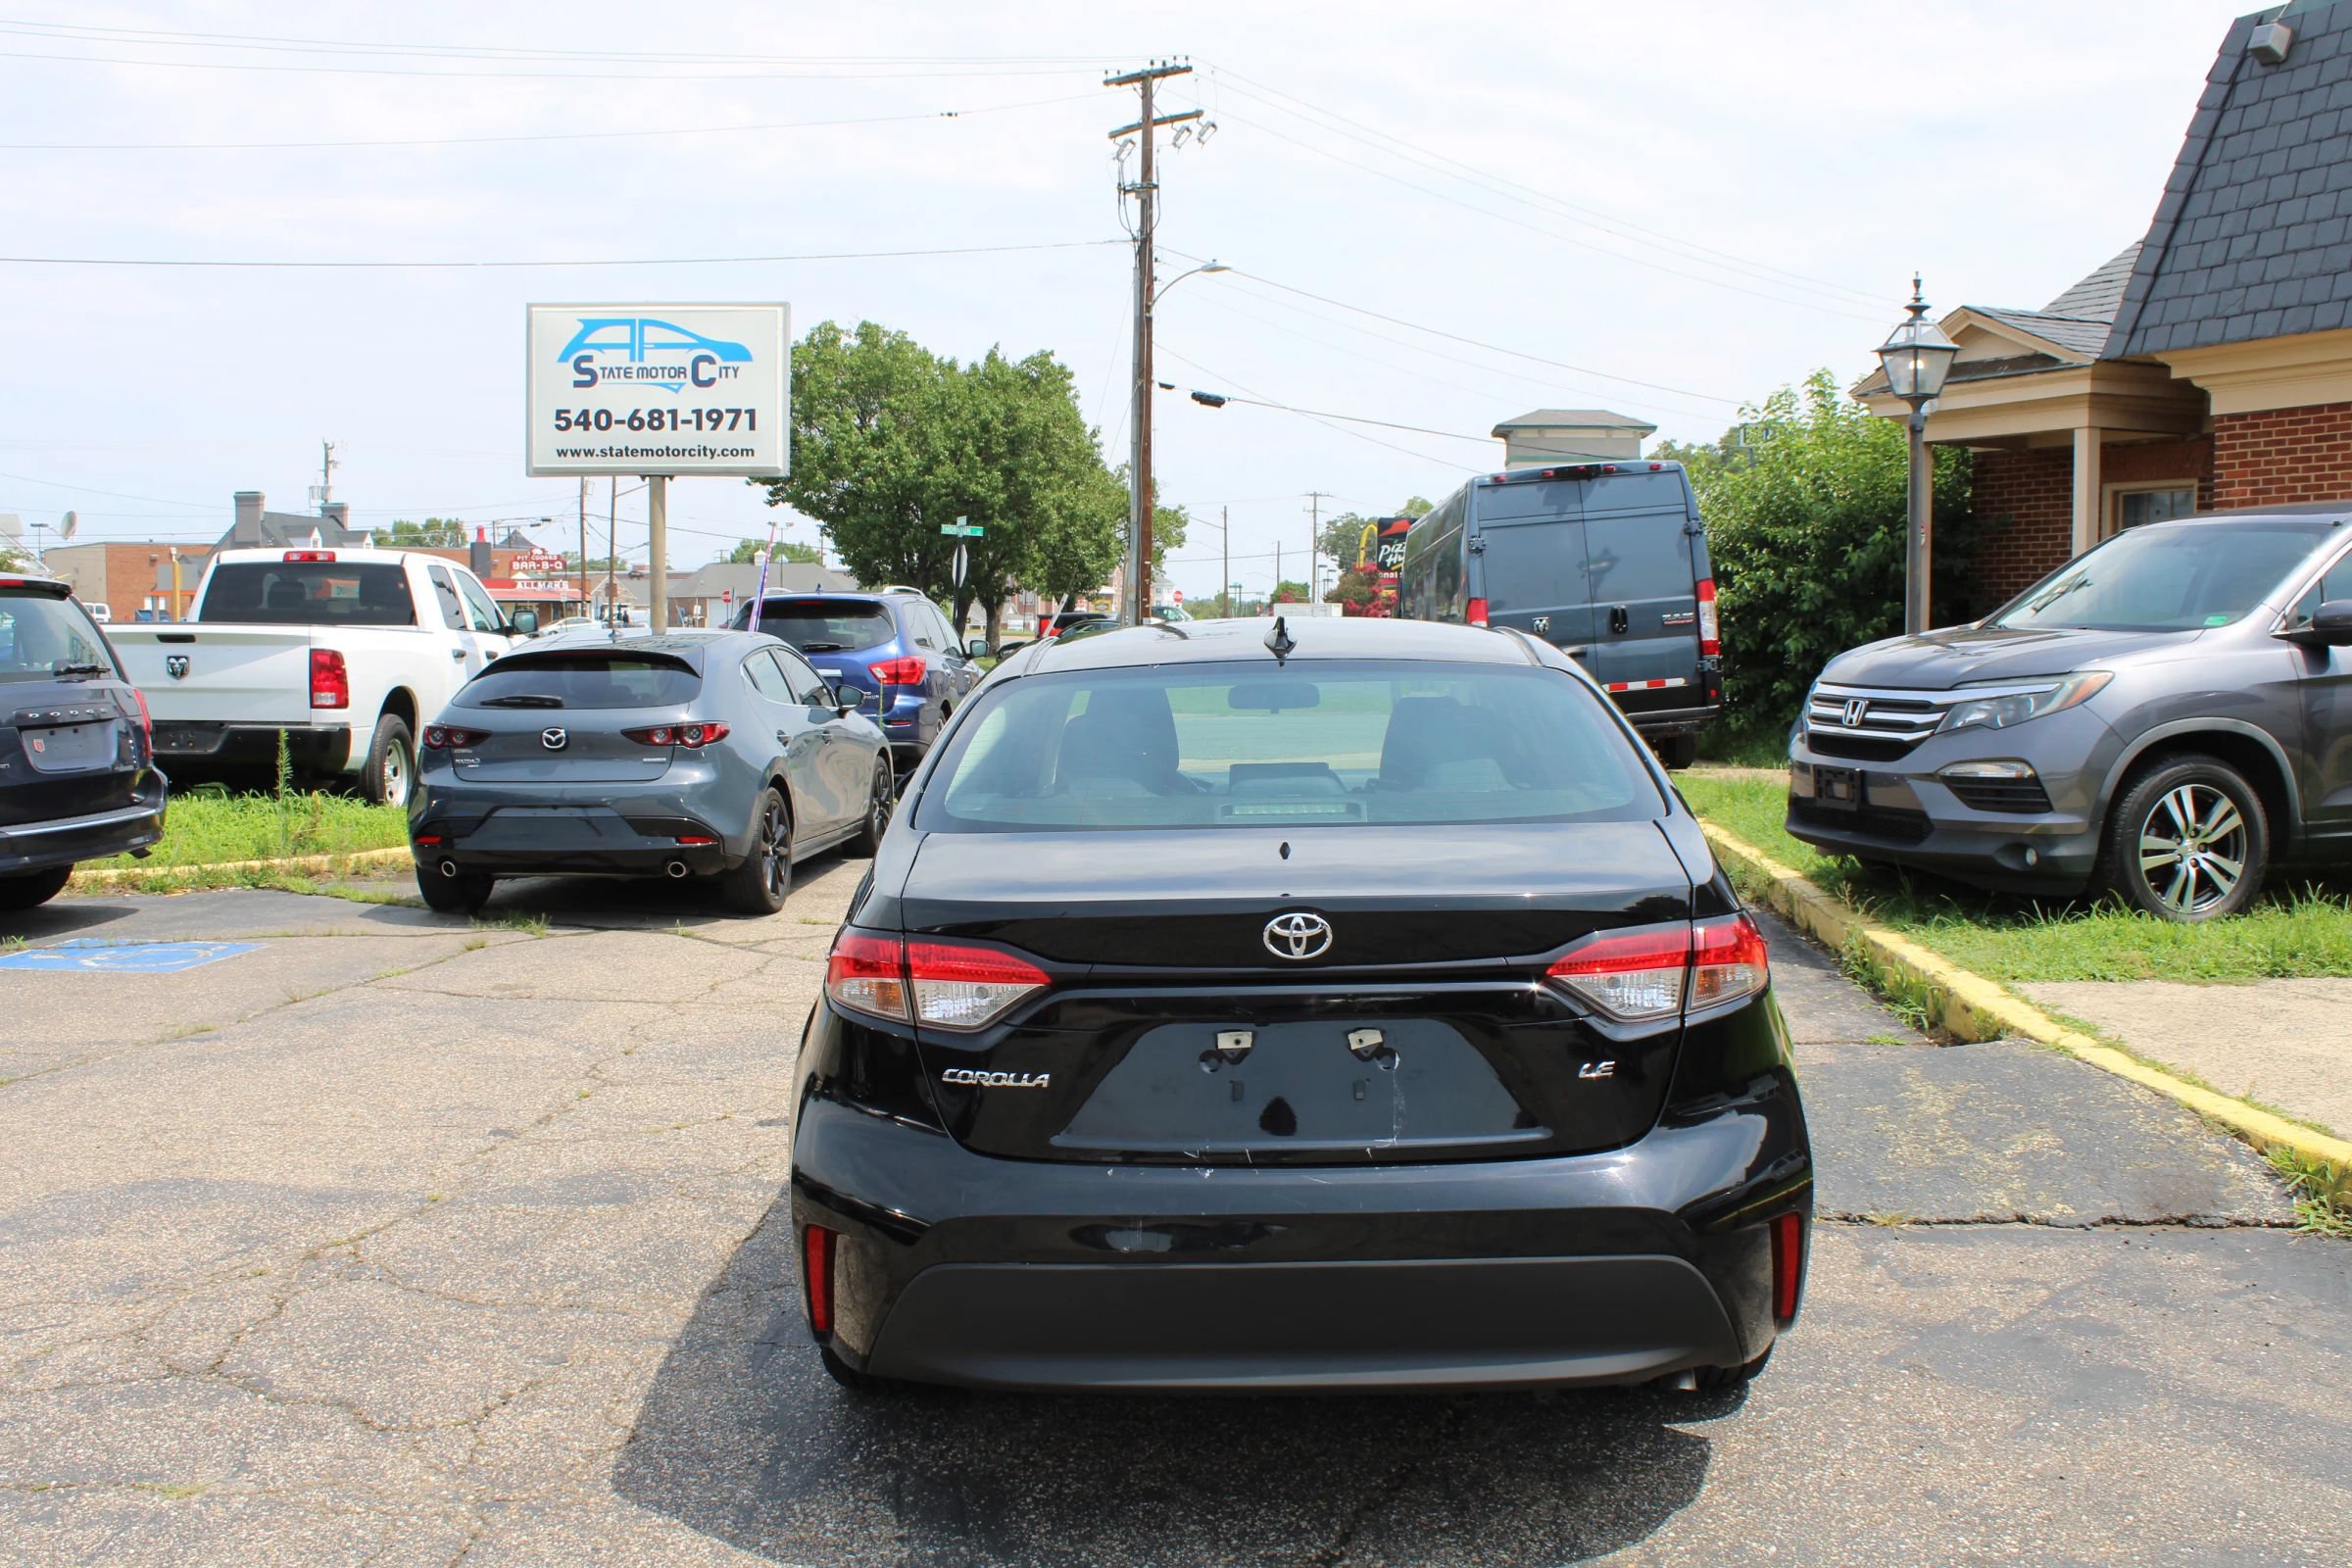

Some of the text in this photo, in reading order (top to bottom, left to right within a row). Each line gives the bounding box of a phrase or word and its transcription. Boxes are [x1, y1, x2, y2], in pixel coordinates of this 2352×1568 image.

[554, 408, 757, 431] 540-681-1971
[556, 444, 755, 460] www.statemotorcity.com
[512, 561, 564, 570] BAR-B-Q
[942, 1068, 1051, 1088] COROLLA
[1578, 1060, 1616, 1078] LE
